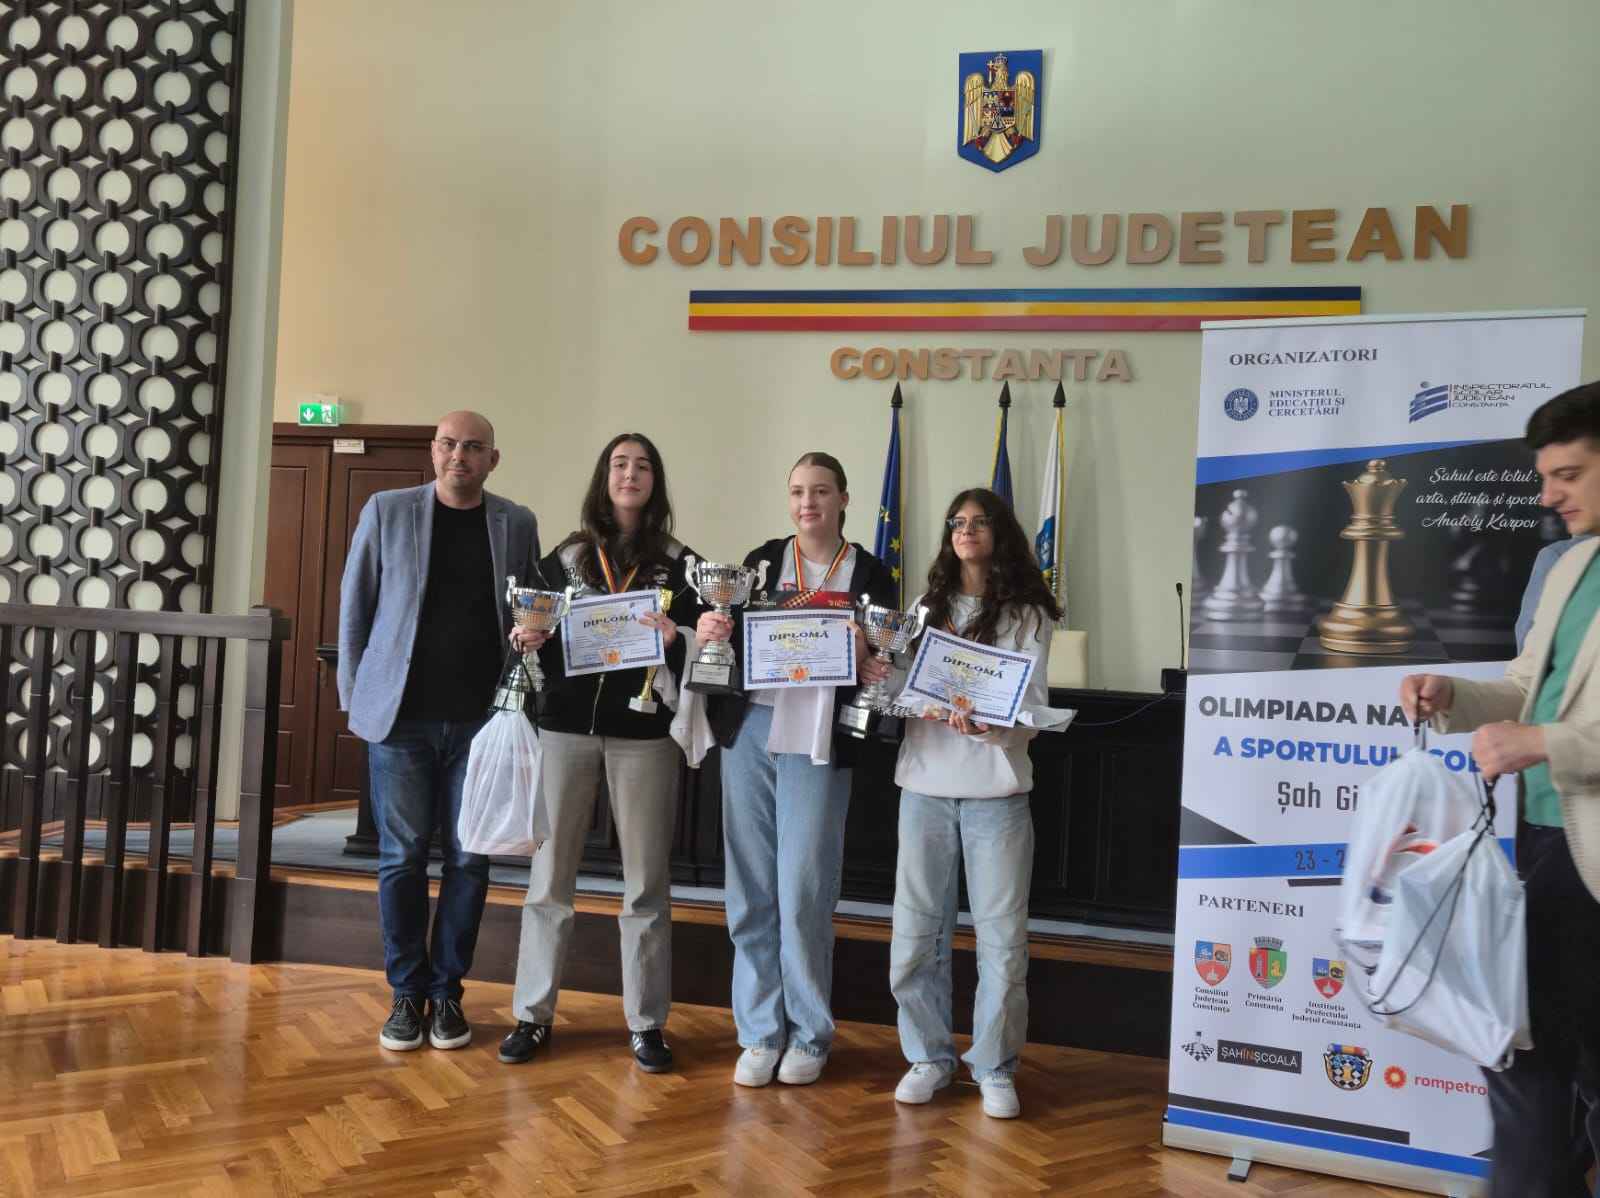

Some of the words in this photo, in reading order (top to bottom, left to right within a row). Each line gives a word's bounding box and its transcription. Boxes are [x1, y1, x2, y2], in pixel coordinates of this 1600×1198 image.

[618, 213, 993, 268] CONSILIUL
[1023, 205, 1471, 267] JUDETEAN
[830, 346, 1132, 382] CONSTANTA
[1229, 348, 1378, 367] ORGANIZATORI
[1270, 388, 1342, 399] MINISTERUL
[1453, 382, 1553, 390] INSPECTORATUL
[1474, 469, 1498, 482] este
[1421, 511, 1484, 532] Anatoly
[1486, 513, 1539, 531] Karpov
[1199, 695, 1358, 725] OLIMPIADA
[1213, 735, 1233, 757] A
[1296, 847, 1316, 871] 23
[1198, 893, 1305, 918] PARTENERI
[1414, 1075, 1488, 1096] rompetro
